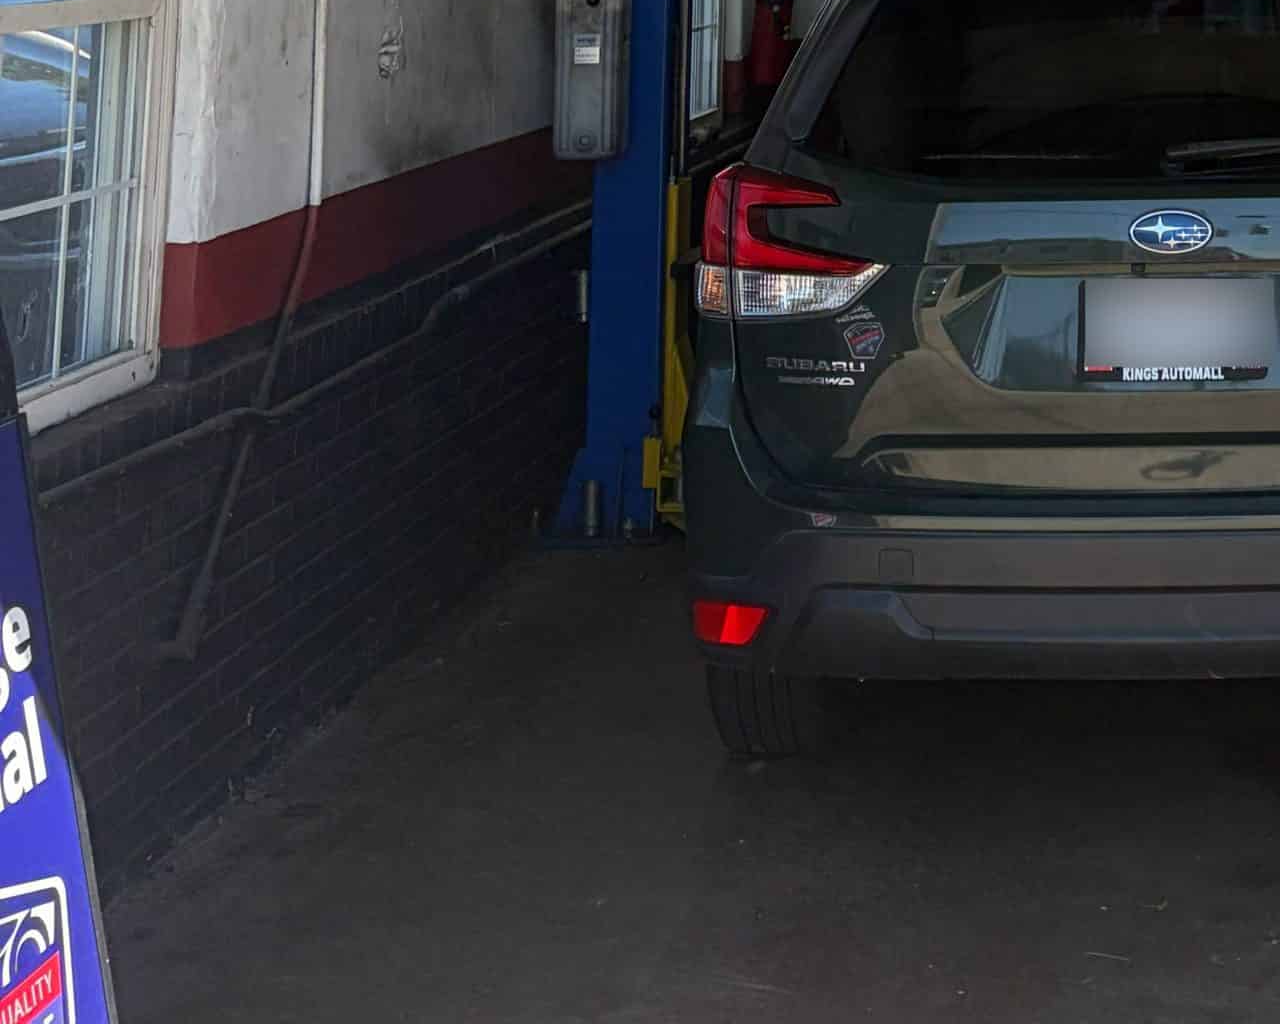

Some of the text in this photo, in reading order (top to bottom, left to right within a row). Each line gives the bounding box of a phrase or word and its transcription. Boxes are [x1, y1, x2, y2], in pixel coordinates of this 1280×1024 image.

[765, 356, 866, 373] SUBARU
[1122, 366, 1225, 382] KINGS AUTOMALL
